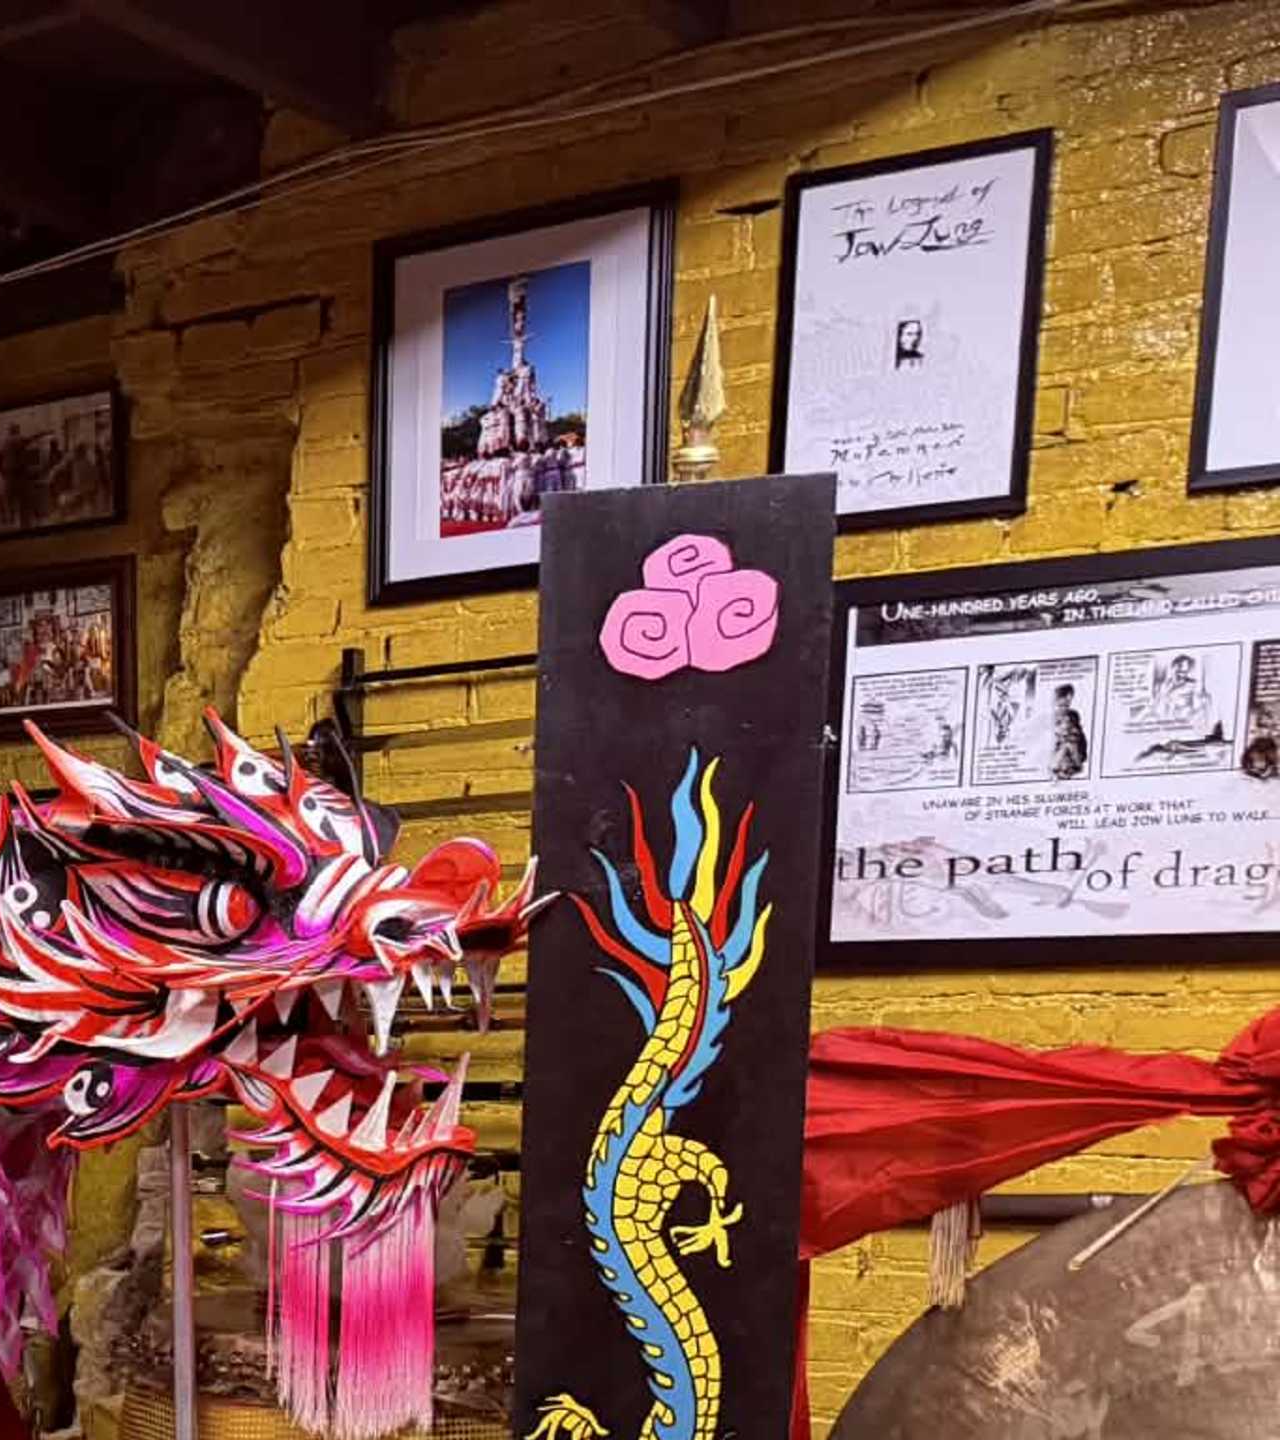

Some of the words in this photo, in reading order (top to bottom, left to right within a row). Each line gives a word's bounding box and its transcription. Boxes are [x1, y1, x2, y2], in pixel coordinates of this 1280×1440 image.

[1008, 591, 1058, 611] YEARS
[1062, 607, 1086, 623] IN
[1091, 603, 1126, 620] THE
[1006, 794, 1030, 806] HIS
[964, 810, 982, 822] OF
[985, 806, 1041, 821] STRANGE
[1044, 803, 1090, 817] FORCES
[1093, 803, 1111, 815] AT
[1116, 801, 1153, 813] WORK
[1094, 816, 1127, 829] LEAD
[1209, 812, 1227, 823] TO
[838, 847, 923, 881] the
[944, 838, 1087, 889] path
[1086, 852, 1144, 892] of
[1153, 850, 1280, 901] drag
